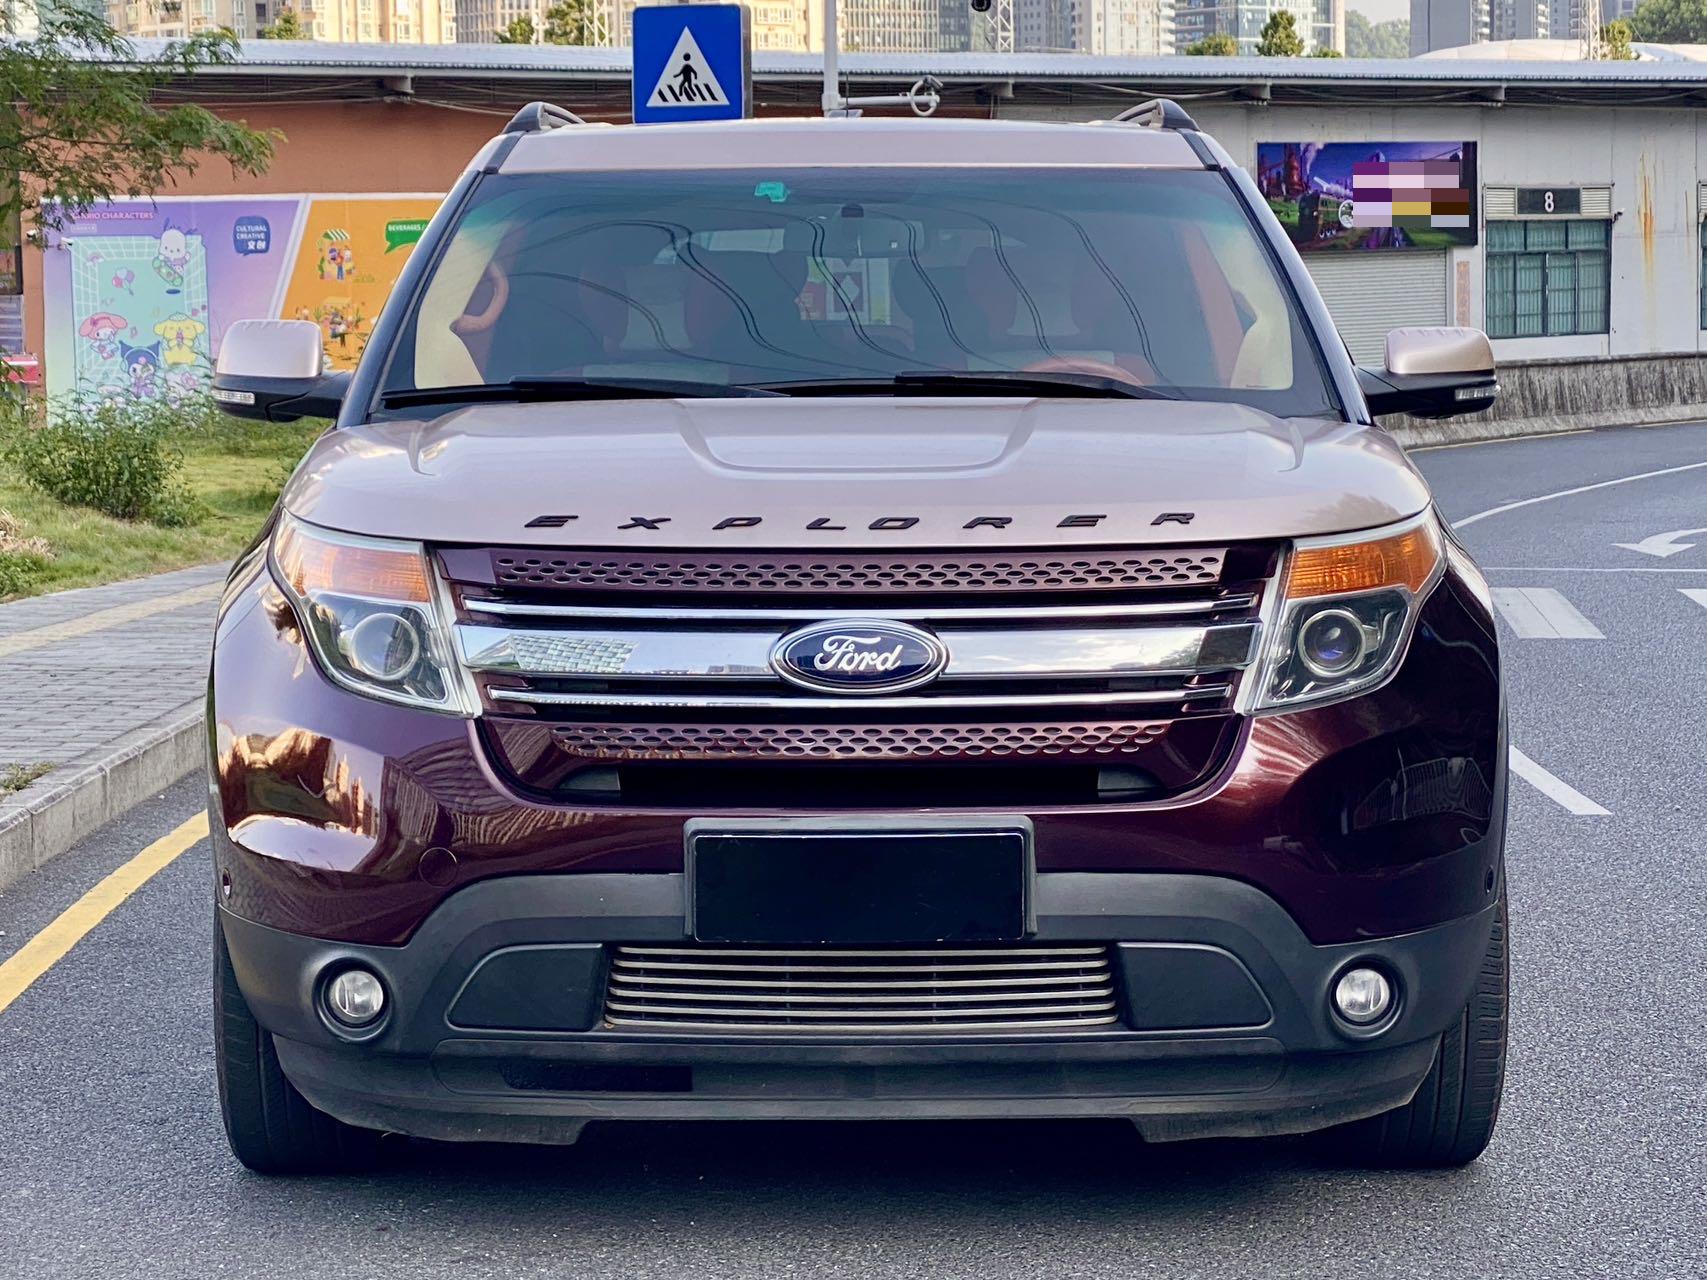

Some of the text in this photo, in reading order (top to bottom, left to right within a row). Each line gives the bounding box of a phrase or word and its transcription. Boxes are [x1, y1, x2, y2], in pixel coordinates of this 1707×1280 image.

[1544, 191, 1555, 213] 8
[101, 211, 154, 220] CHARACTERS
[235, 224, 267, 232] CULTURAL
[235, 232, 265, 240] CREATIVE
[524, 512, 1196, 530] EXPLORER
[813, 634, 903, 671] Ford
